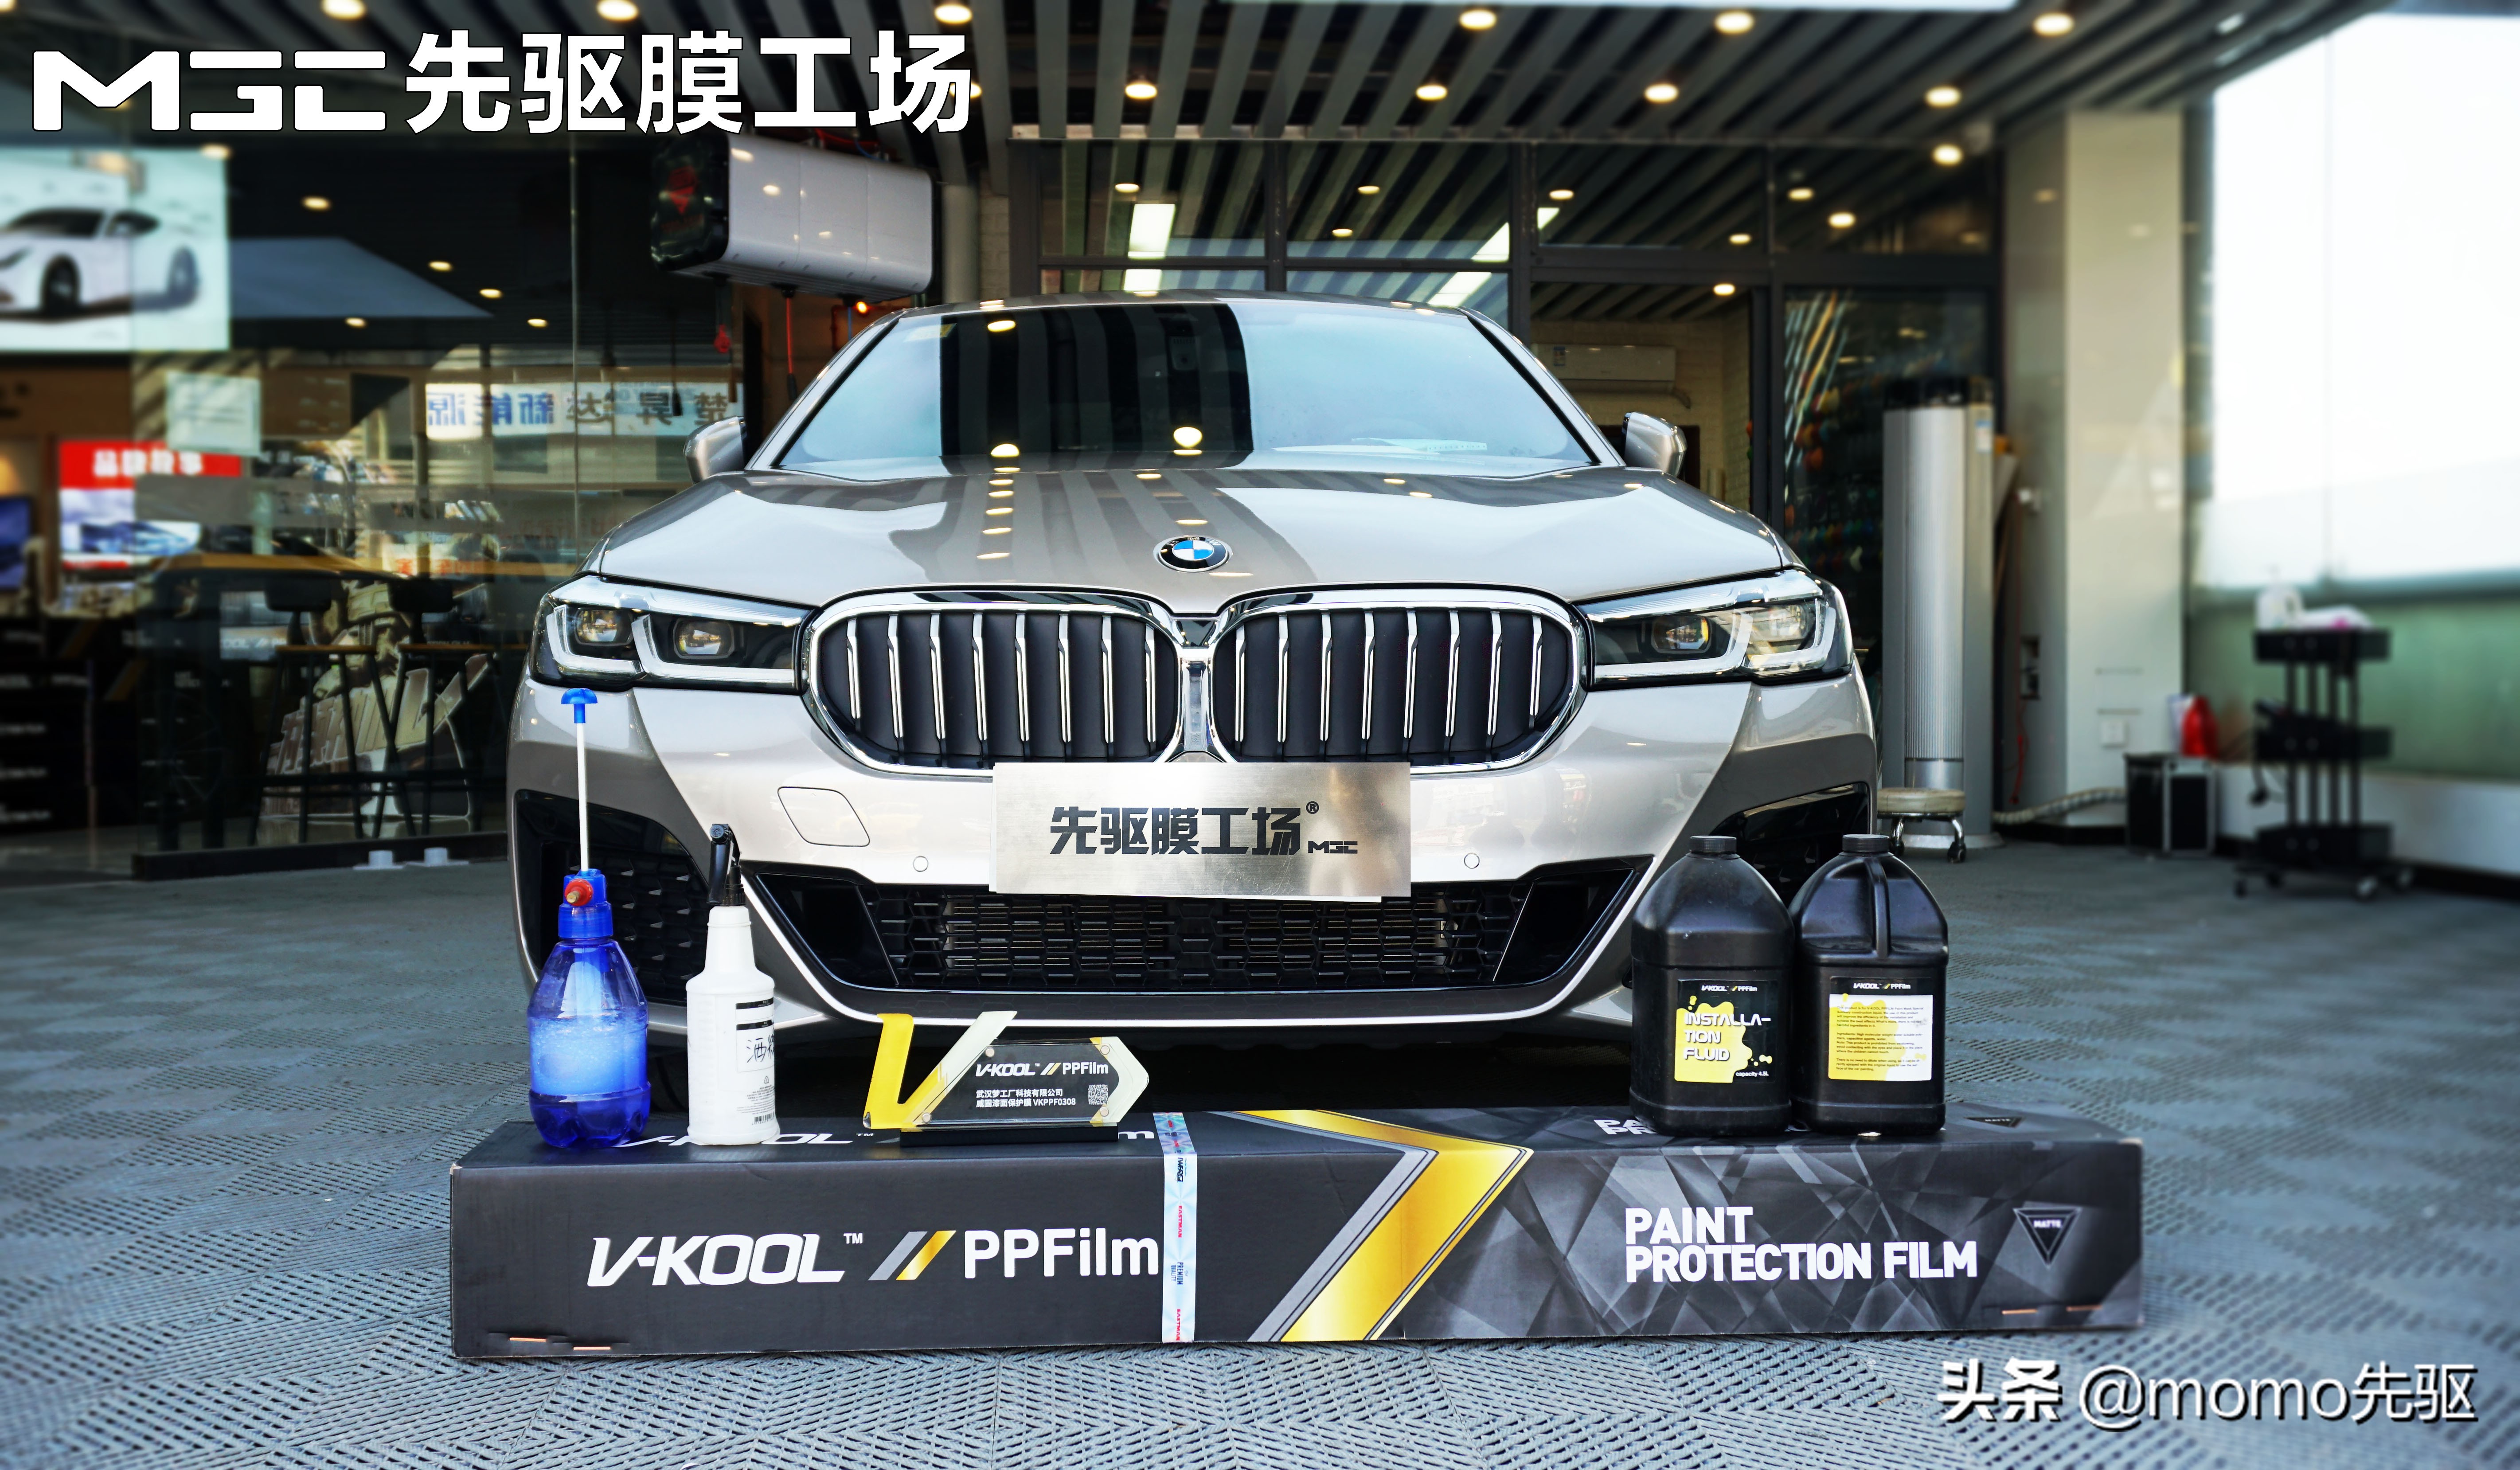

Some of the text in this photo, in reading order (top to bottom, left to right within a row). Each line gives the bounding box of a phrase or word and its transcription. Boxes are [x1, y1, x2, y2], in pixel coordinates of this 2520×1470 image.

[1050, 806, 1301, 856] 先驱膜工场
[1684, 1012, 1771, 1026] INSTALLA-
[1684, 1030, 1721, 1044] TION
[1684, 1048, 1730, 1061] FLUID
[975, 1063, 1036, 1077] V-KOOL
[1062, 1062, 1109, 1075] PPFilm
[976, 1088, 1063, 1098] 武汉梦工厂科技有限公司
[976, 1098, 1032, 1108] 威固漆面保护膜
[1625, 1206, 1753, 1245] PAINT
[586, 1233, 845, 1287] V-KOOL
[965, 1228, 1159, 1278] PPFilm
[1625, 1240, 1978, 1283] PROTECTION FILM
